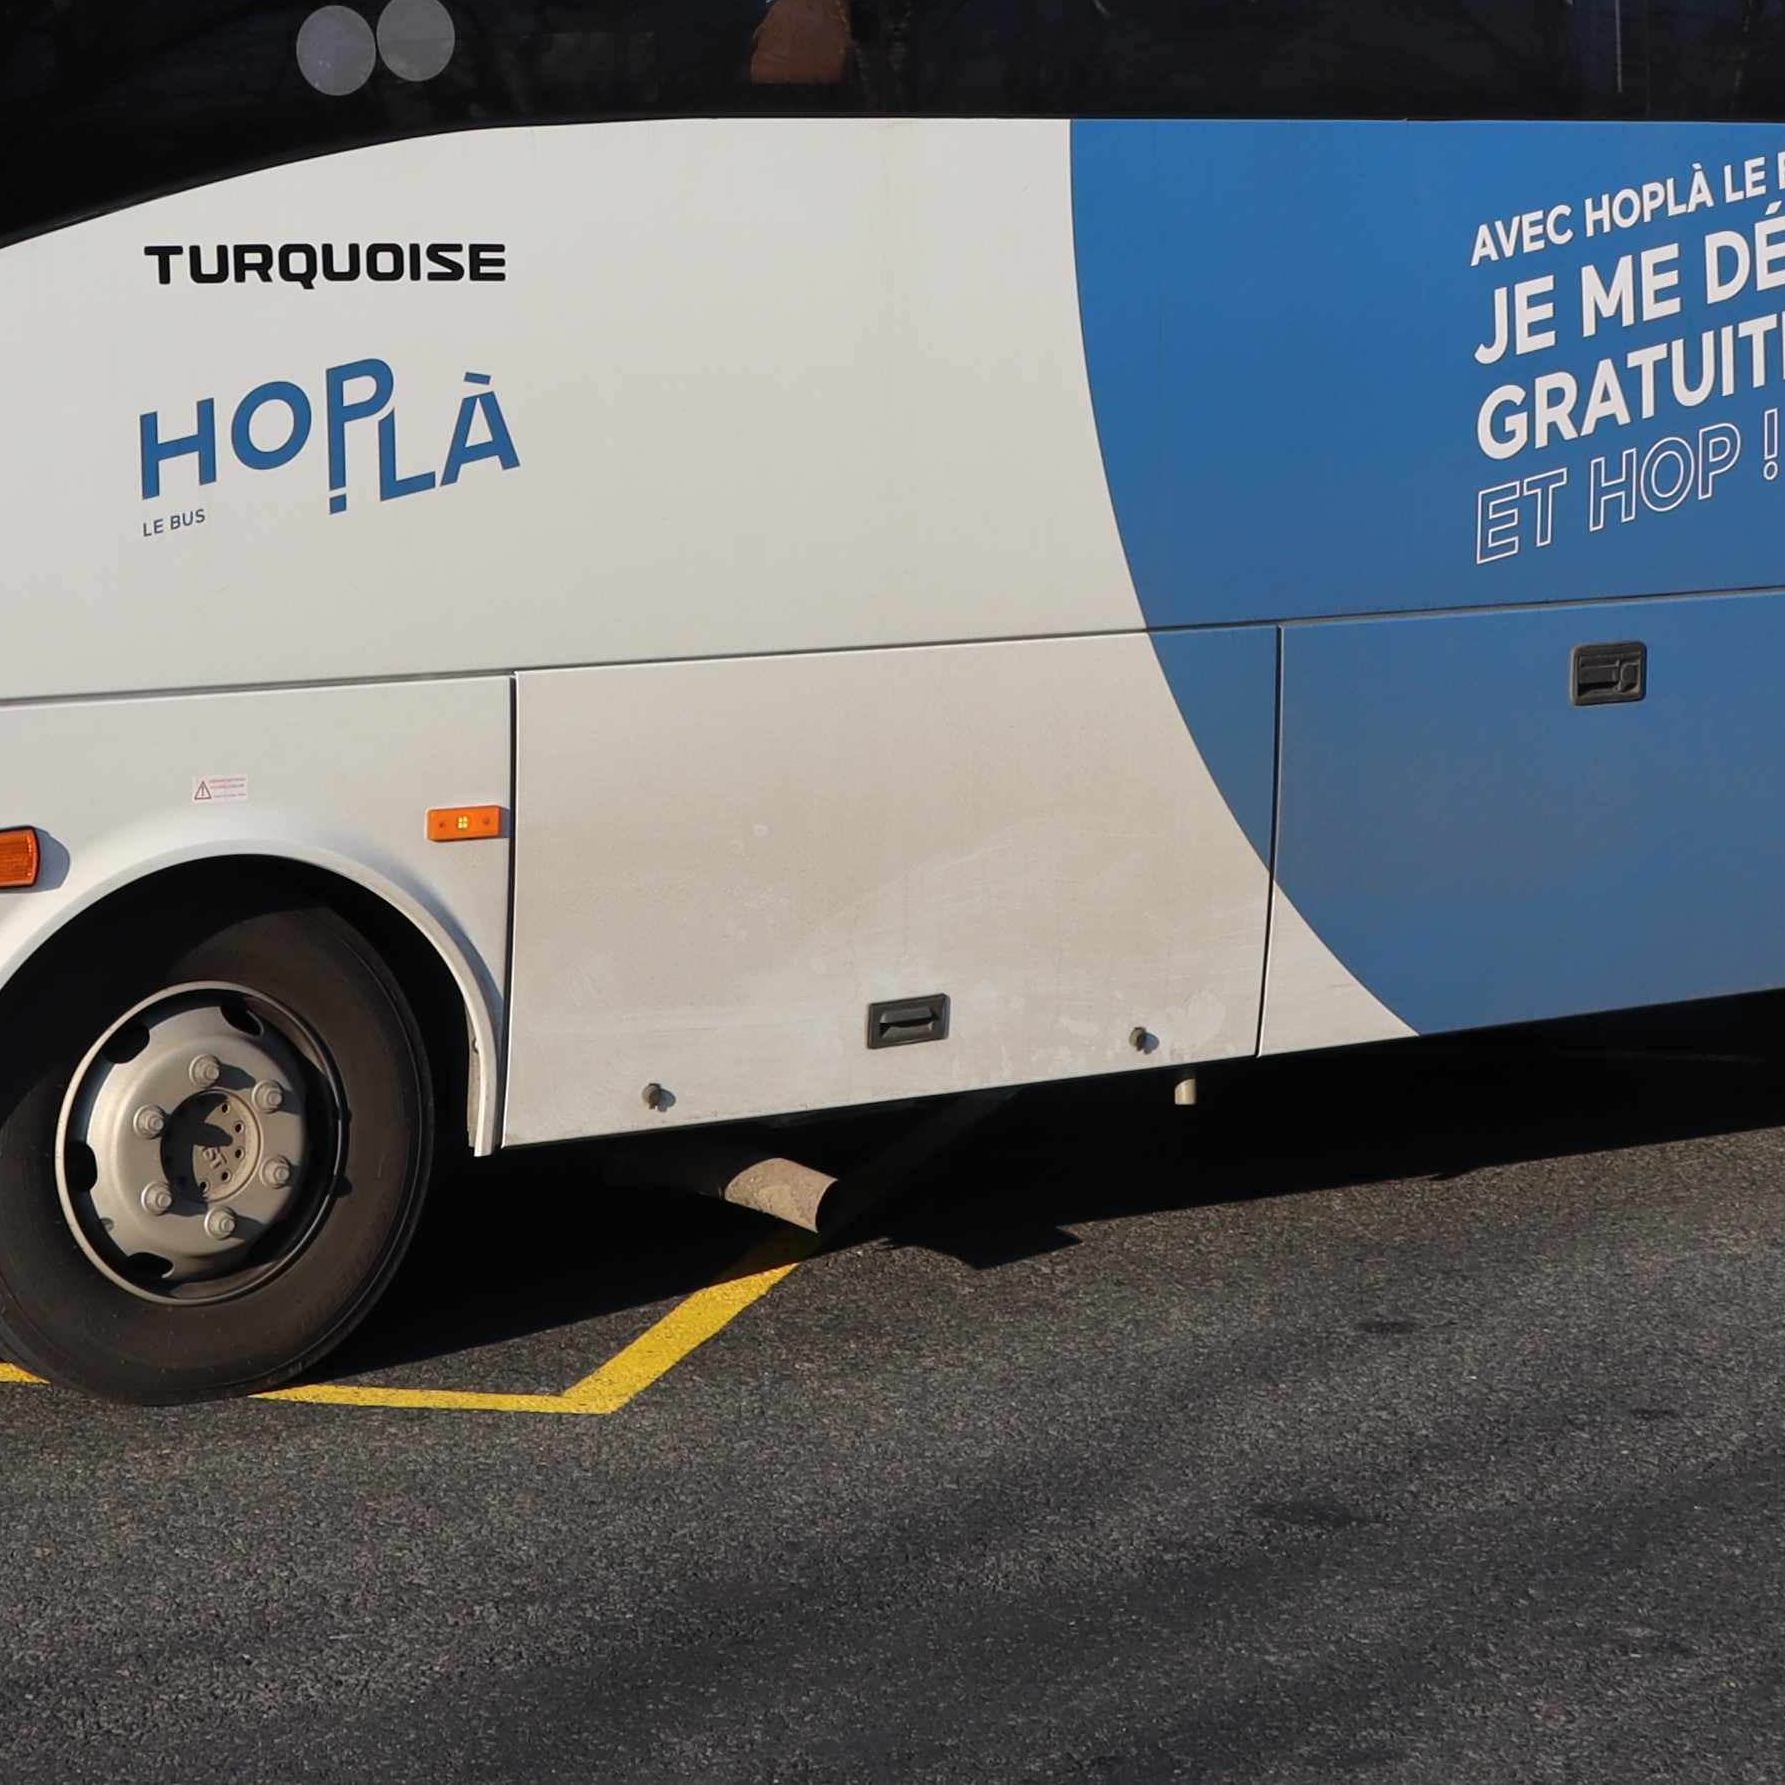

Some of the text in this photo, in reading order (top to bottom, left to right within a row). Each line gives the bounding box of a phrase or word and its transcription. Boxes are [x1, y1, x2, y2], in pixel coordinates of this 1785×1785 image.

[143, 241, 508, 290] TURQUOISE
[1470, 206, 1574, 267] AVEC
[1584, 162, 1715, 238] HOPLÀ
[1723, 155, 1767, 204] LE
[1473, 274, 1557, 365] JE
[1581, 242, 1682, 339] ME
[142, 507, 207, 538] LE BUS
[1475, 466, 1569, 566] ET
[1588, 421, 1742, 533] HOP
